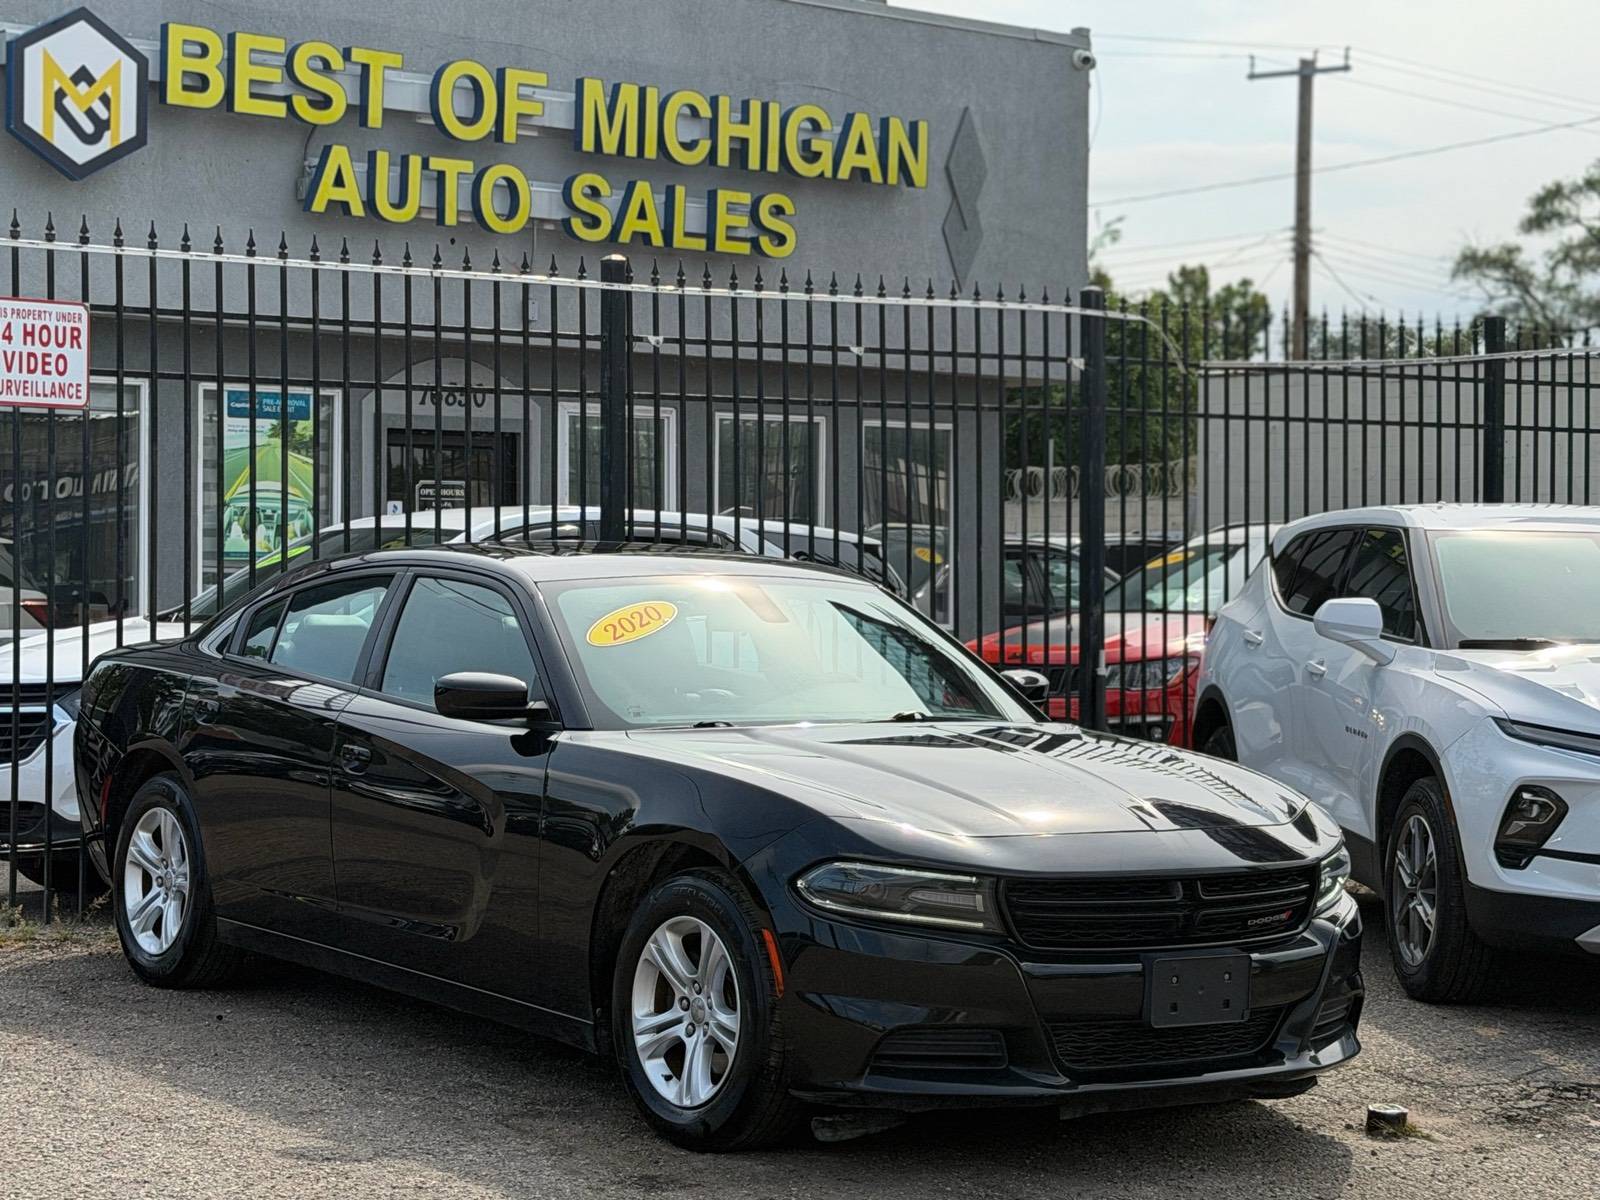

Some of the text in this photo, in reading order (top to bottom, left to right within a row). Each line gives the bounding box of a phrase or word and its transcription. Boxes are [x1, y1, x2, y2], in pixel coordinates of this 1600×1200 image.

[161, 22, 929, 188] BEST OF MICHIGAN
[305, 145, 797, 258] AUTO SALES
[10, 308, 53, 322] PROPERTY
[55, 311, 83, 324] UNDER
[22, 323, 83, 350] HOUR
[2, 350, 68, 377] VIDEO
[420, 488, 465, 497] OPE HOURS
[603, 605, 662, 641] 2020
